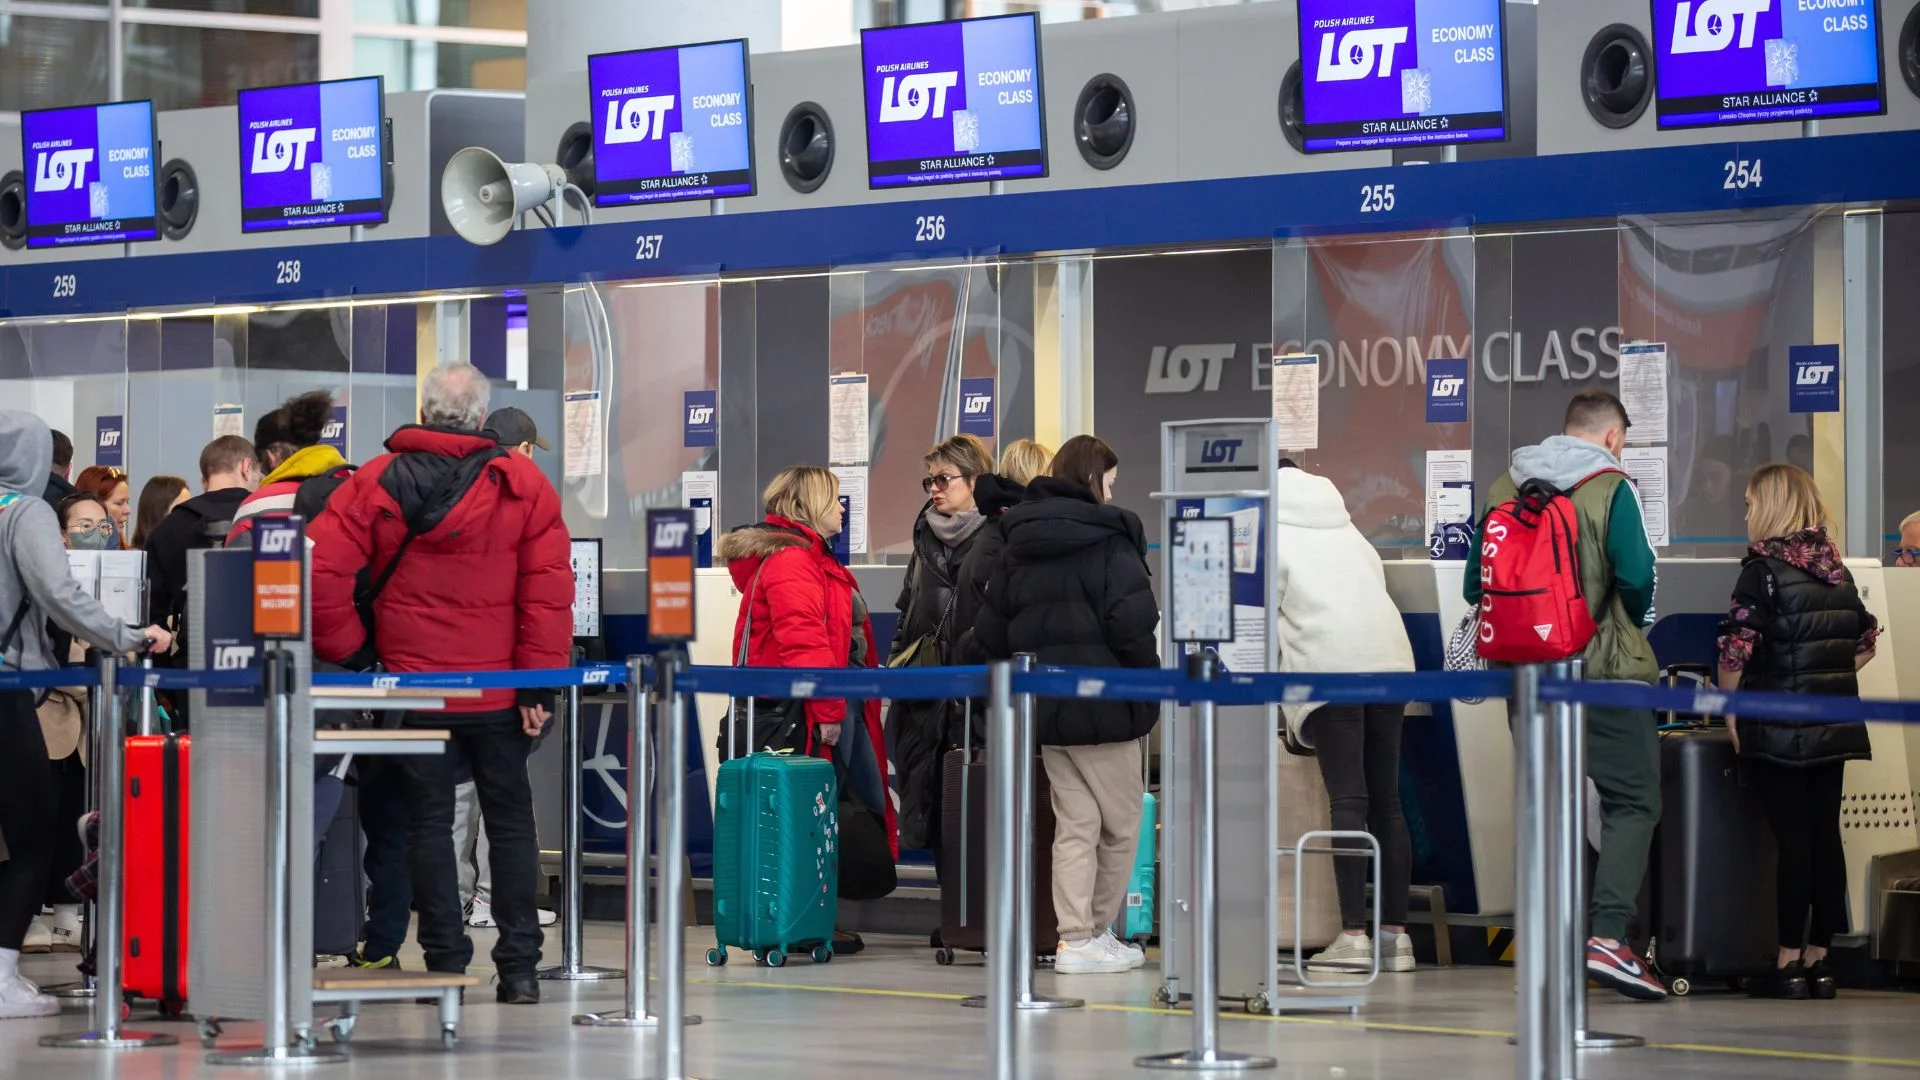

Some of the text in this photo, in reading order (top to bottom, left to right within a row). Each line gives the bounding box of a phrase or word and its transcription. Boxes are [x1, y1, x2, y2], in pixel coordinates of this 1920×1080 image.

[1314, 16, 1374, 28] POLISH AIRLINES
[1670, 0, 1771, 54] LOT
[1824, 14, 1868, 32] CLASS
[1432, 24, 1494, 42] ECONOMY
[1316, 26, 1408, 82] LOT
[1454, 47, 1494, 64] CLASS
[876, 60, 928, 72] POLISH AIRLINES
[978, 68, 1032, 86] ECONOMY
[602, 85, 649, 97] POLISH AIRLINES
[879, 71, 958, 123] LOT
[998, 89, 1033, 105] CLASS
[693, 92, 741, 109] ECONOMY
[1723, 92, 1806, 108] STAR ALLIANCE
[604, 95, 675, 144] LOT
[711, 112, 742, 127] CLASS
[1363, 119, 1437, 134] STAR ALLIANCE
[332, 126, 376, 142] ECONOMY
[109, 147, 148, 162] ECONOMY
[251, 128, 316, 174] LOT
[348, 144, 376, 159] CLASS
[34, 148, 94, 192] LOT
[123, 165, 150, 178] CLASS
[920, 156, 985, 170] STAR ALLIANCE
[1724, 159, 1762, 189] 254
[641, 176, 699, 190] STAR ALLIANCE
[1360, 184, 1395, 212] 255
[284, 204, 336, 216] STAR ALLIANCE
[65, 221, 113, 233] STAR ALLIANCE
[916, 215, 946, 241] 256
[636, 235, 663, 259] 257
[277, 260, 301, 284] 258
[53, 274, 76, 297] 259
[1144, 327, 1624, 394] LOT EONOMY CLASS
[1796, 366, 1834, 384] LOT
[1432, 379, 1464, 396] LOT
[964, 396, 991, 413] LOT
[688, 408, 713, 424] LOT
[100, 431, 120, 446] LOT
[1201, 439, 1243, 463] LOT
[260, 529, 297, 553] LOT
[654, 523, 689, 548] LOT
[1480, 520, 1508, 643] GUESS
[213, 646, 255, 670] LOT
[372, 677, 400, 689] LOT
[583, 670, 610, 684] LOT
